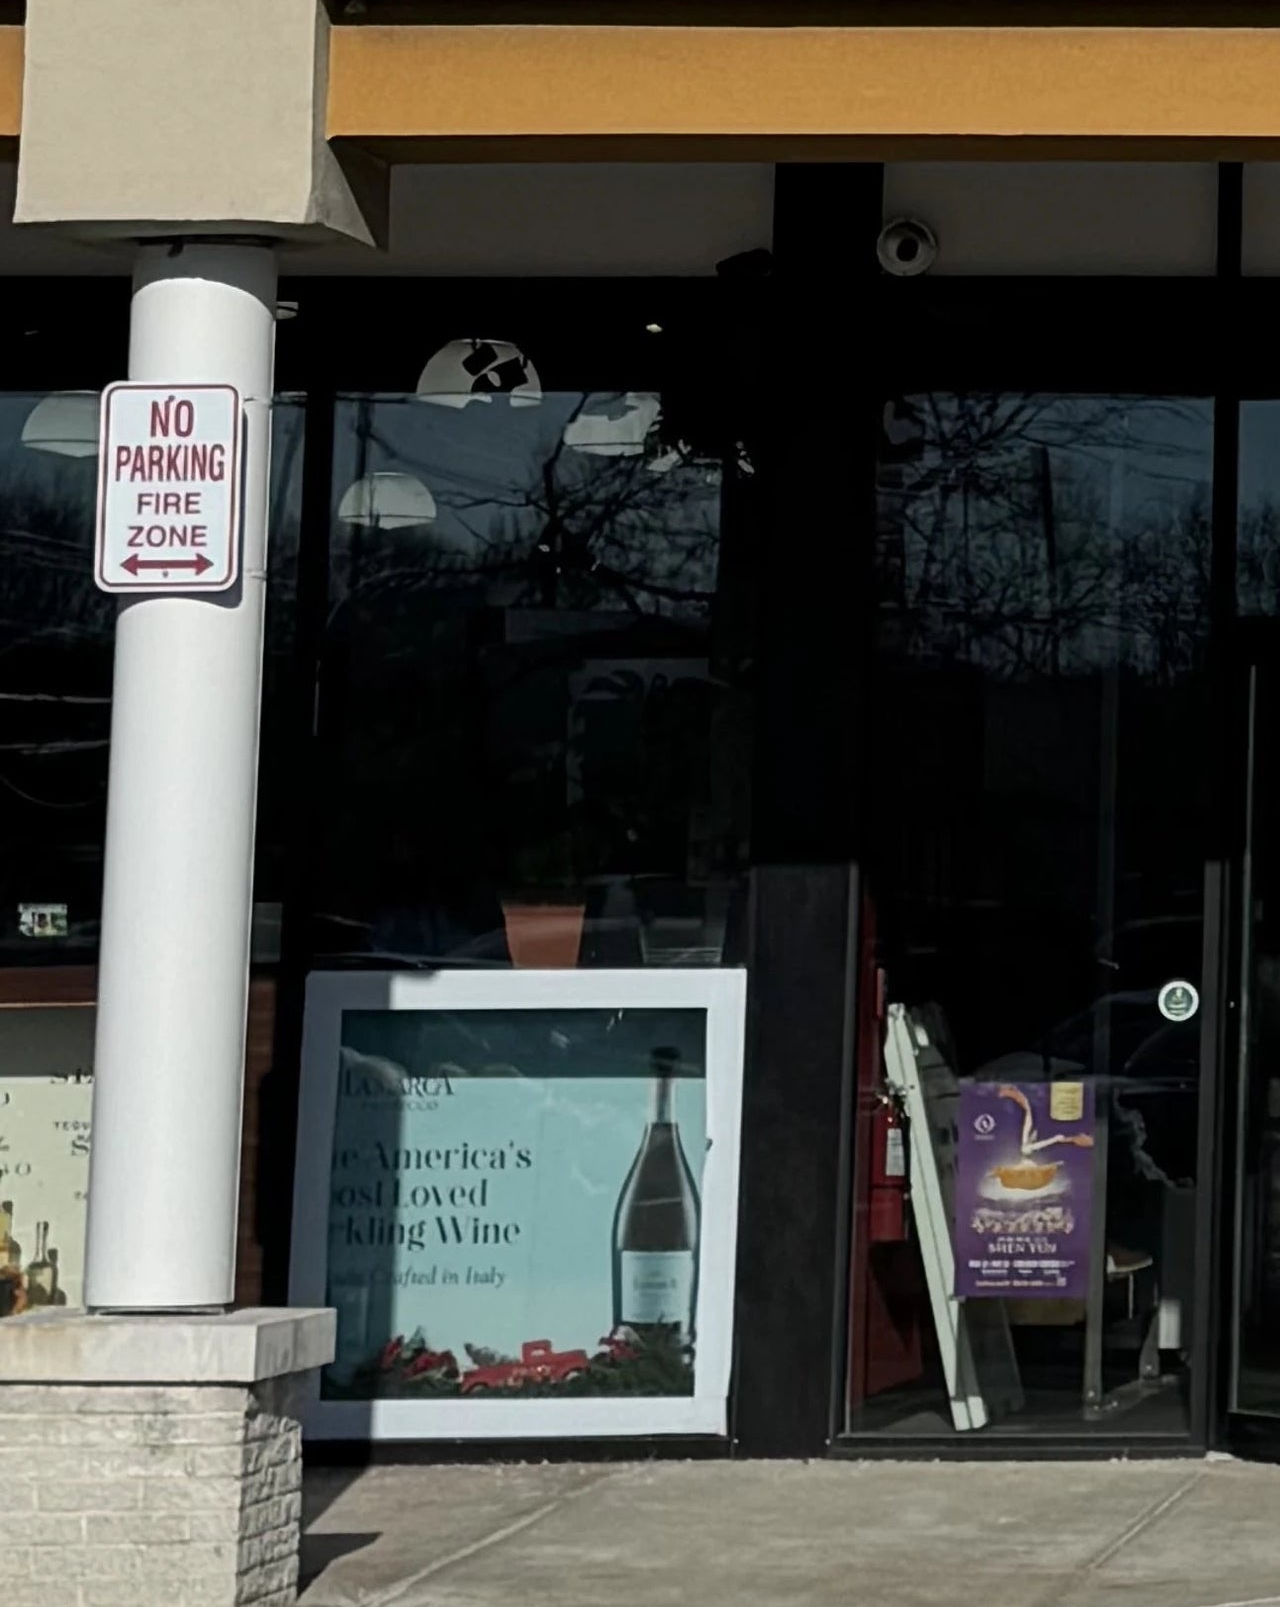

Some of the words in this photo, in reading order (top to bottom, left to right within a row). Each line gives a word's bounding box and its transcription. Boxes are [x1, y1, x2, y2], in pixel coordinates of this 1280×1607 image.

[149, 399, 195, 438] NO
[115, 444, 225, 482] PARKING
[137, 492, 202, 515] FIRE
[126, 525, 208, 548] ZONE
[367, 1140, 533, 1170] America's
[335, 1178, 383, 1208] ost
[392, 1177, 488, 1208] Loved
[435, 1215, 521, 1244] Wine
[466, 1266, 506, 1289] Italy
